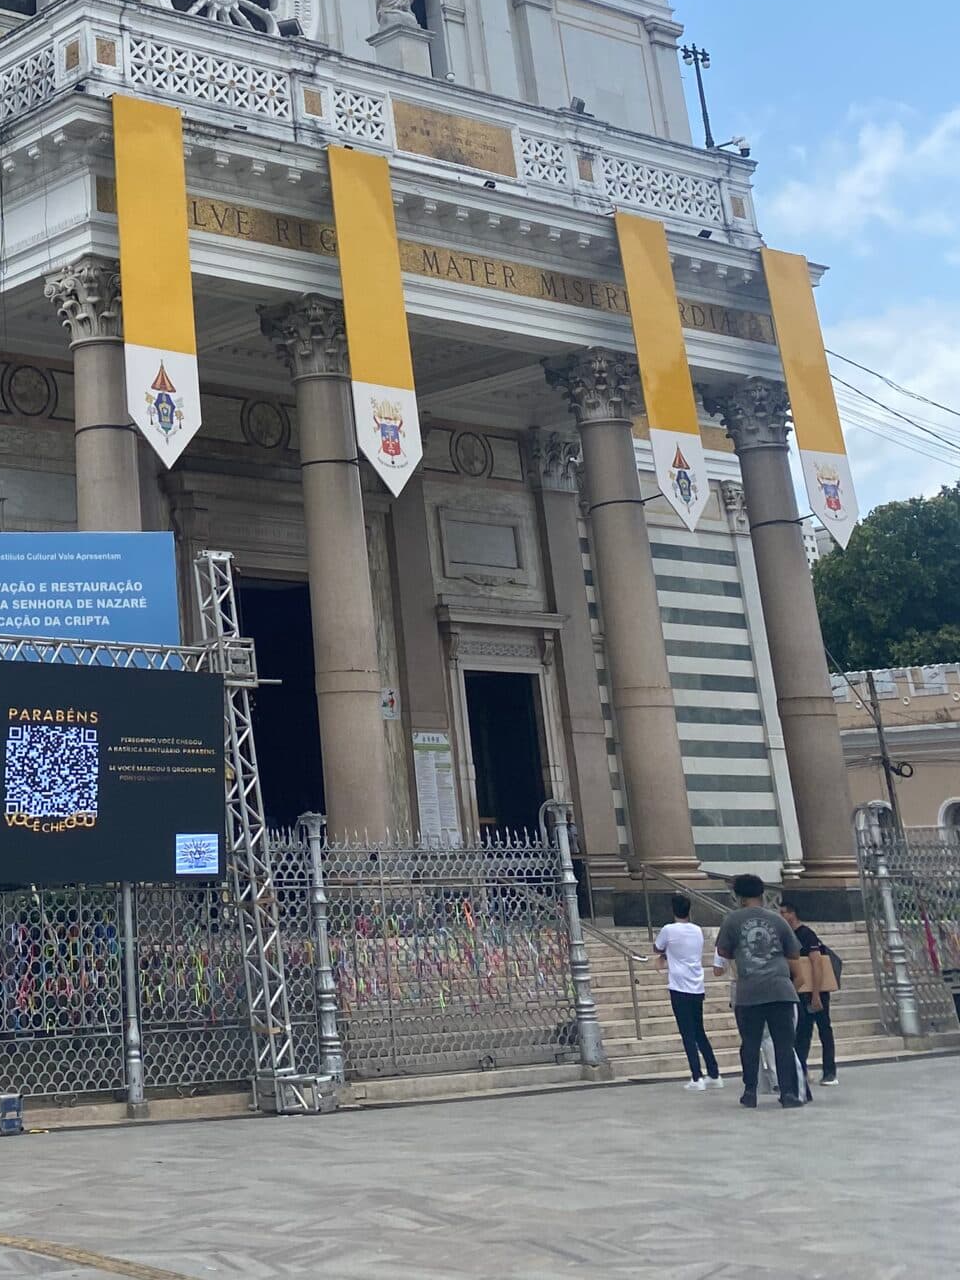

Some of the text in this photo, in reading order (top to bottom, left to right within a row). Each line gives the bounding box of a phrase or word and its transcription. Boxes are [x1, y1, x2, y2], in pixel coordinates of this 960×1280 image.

[192, 201, 250, 236] LVE
[275, 218, 337, 252] REG
[421, 249, 517, 288] MATER
[26, 552, 57, 561] Cultural
[76, 552, 121, 562] Apresentam
[40, 583, 47, 593] E
[52, 581, 142, 594] RESTAURAÇÃO
[12, 599, 73, 610] SENHORA
[77, 599, 93, 610] DE
[97, 596, 147, 609] NAZARÉ
[44, 616, 60, 626] DA
[65, 616, 110, 626] CRIPTA
[8, 707, 98, 723] PARABÉNS
